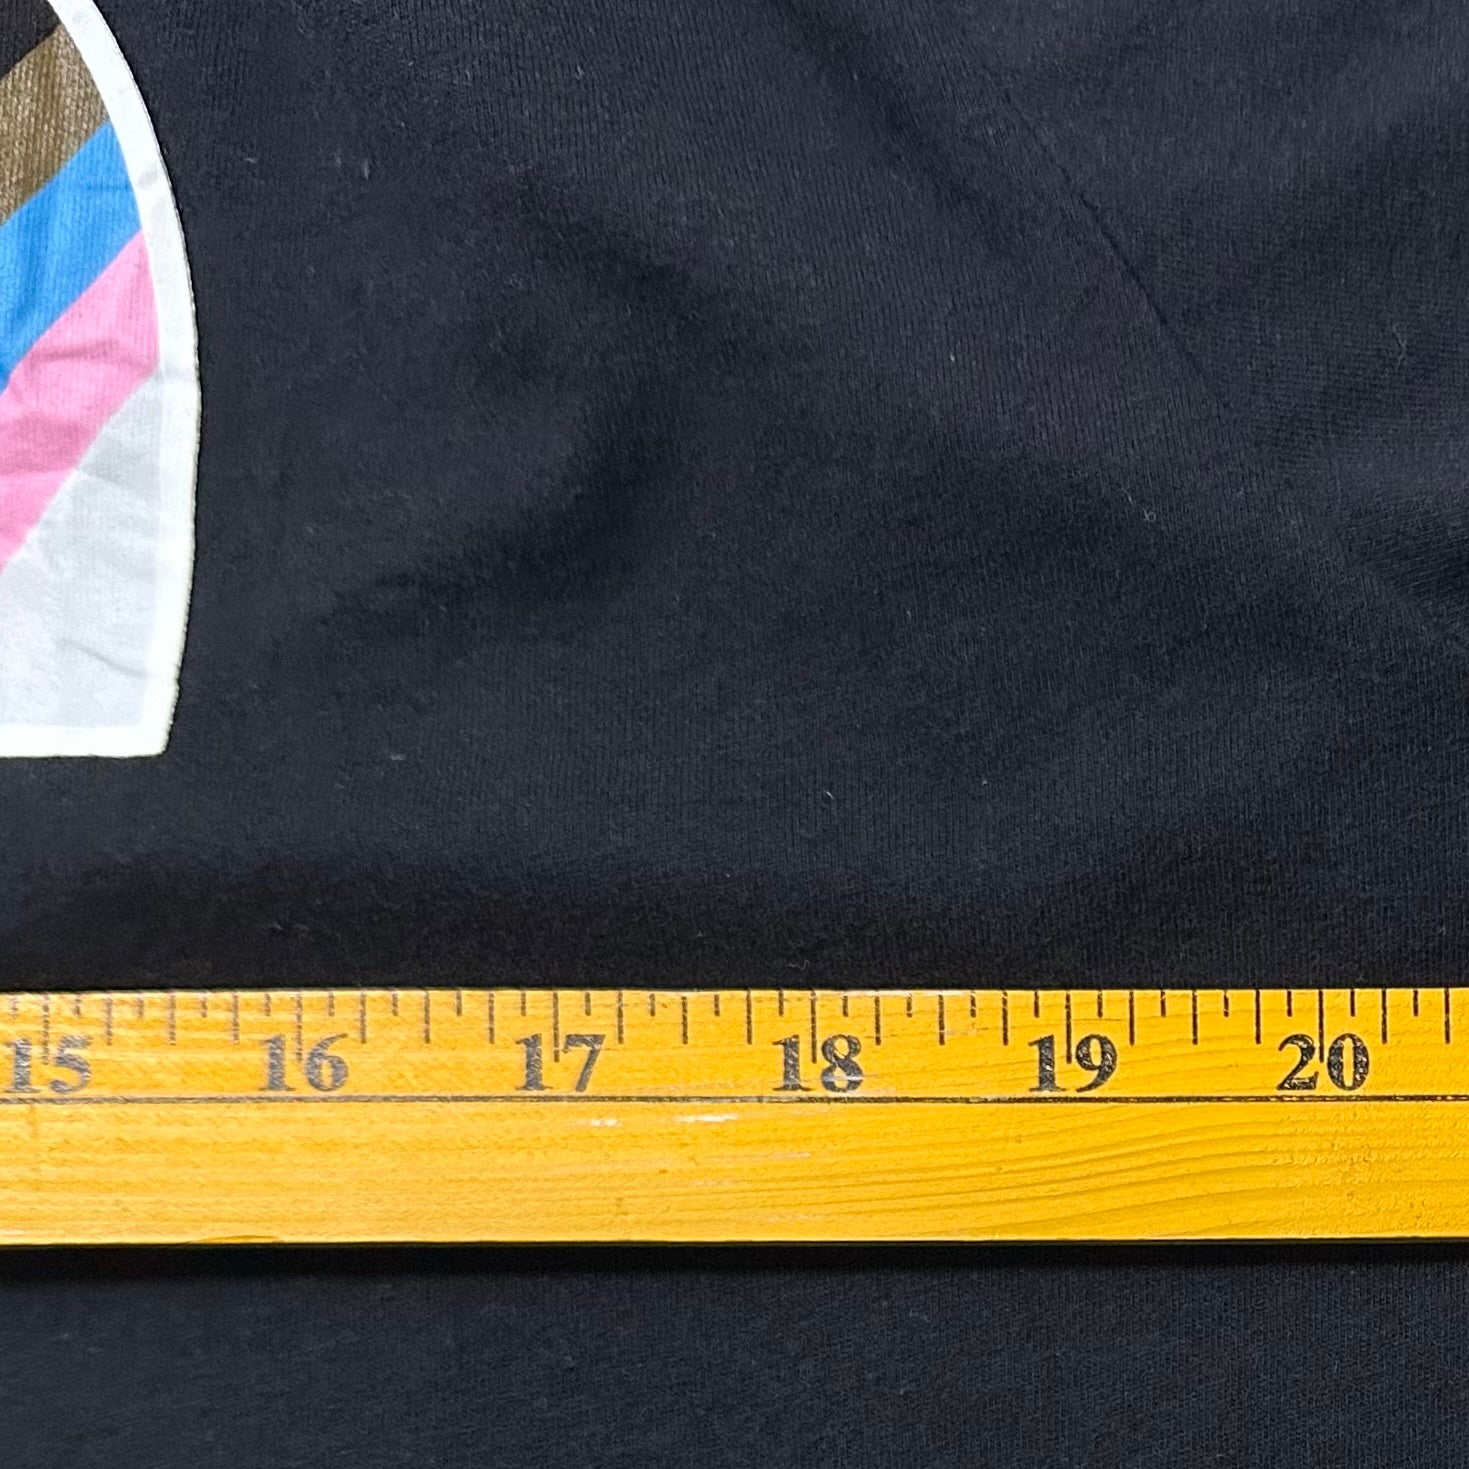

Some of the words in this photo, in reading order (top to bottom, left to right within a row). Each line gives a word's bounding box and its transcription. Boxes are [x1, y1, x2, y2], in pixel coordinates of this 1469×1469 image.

[2, 1034, 93, 1094] 15
[258, 1033, 349, 1092] 16
[515, 1033, 606, 1092] 17
[772, 1034, 864, 1092] 18
[1028, 1034, 1118, 1093] 19
[1276, 1033, 1370, 1091] 20
